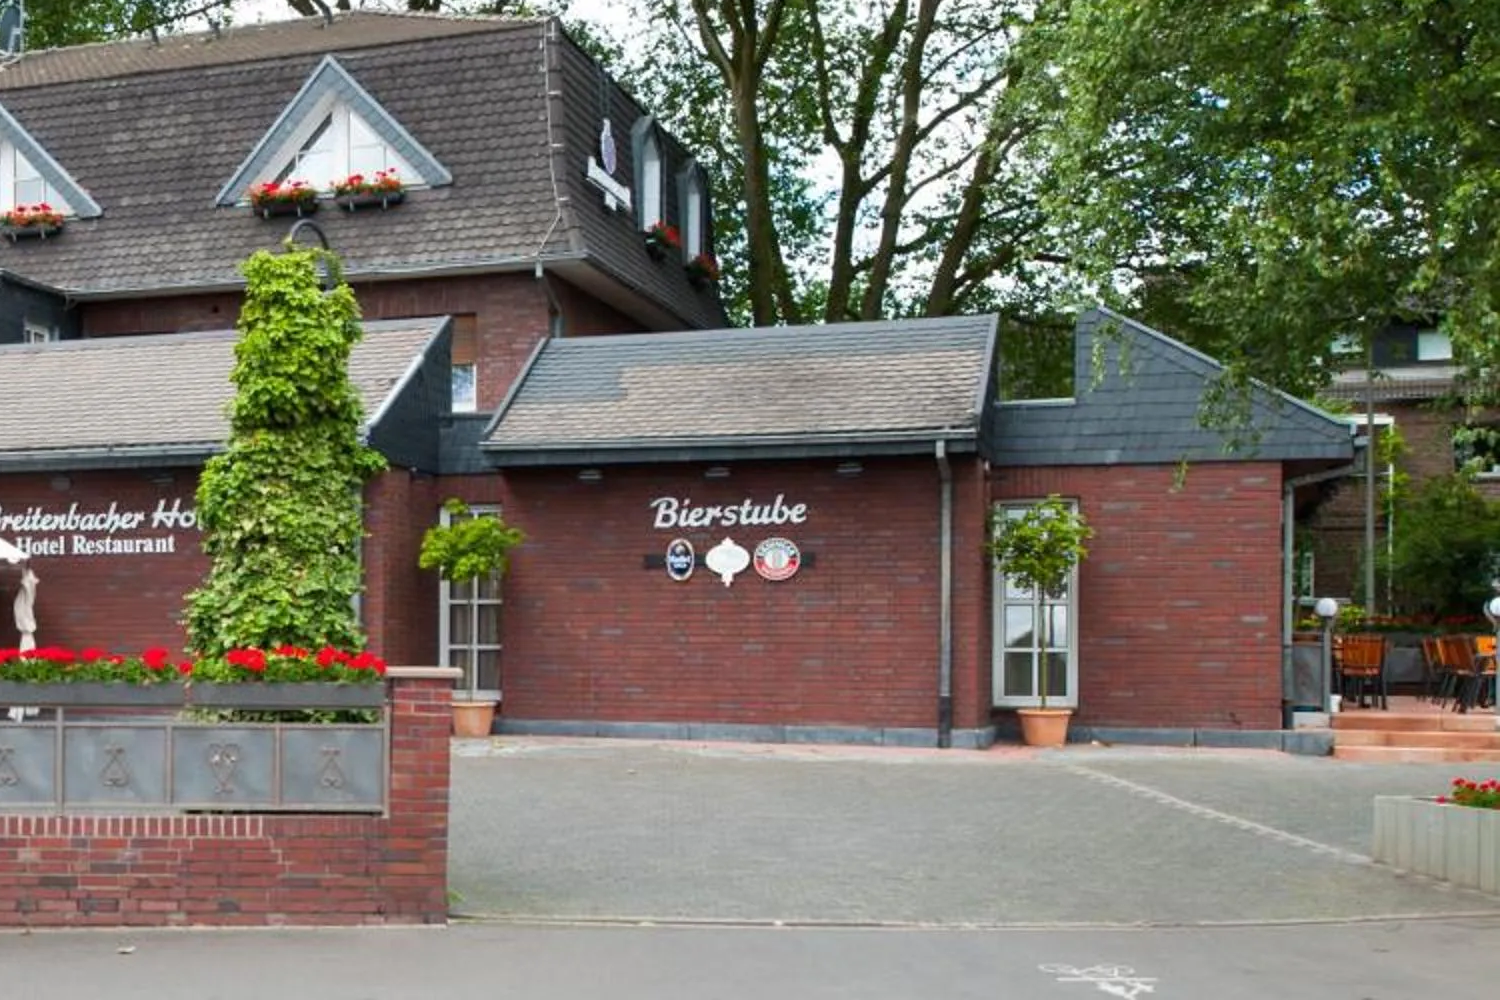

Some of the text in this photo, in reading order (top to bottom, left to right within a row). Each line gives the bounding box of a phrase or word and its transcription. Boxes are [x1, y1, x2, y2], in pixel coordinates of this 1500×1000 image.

[651, 494, 807, 529] Bierstube
[15, 534, 175, 556] Hotel Restaurant
